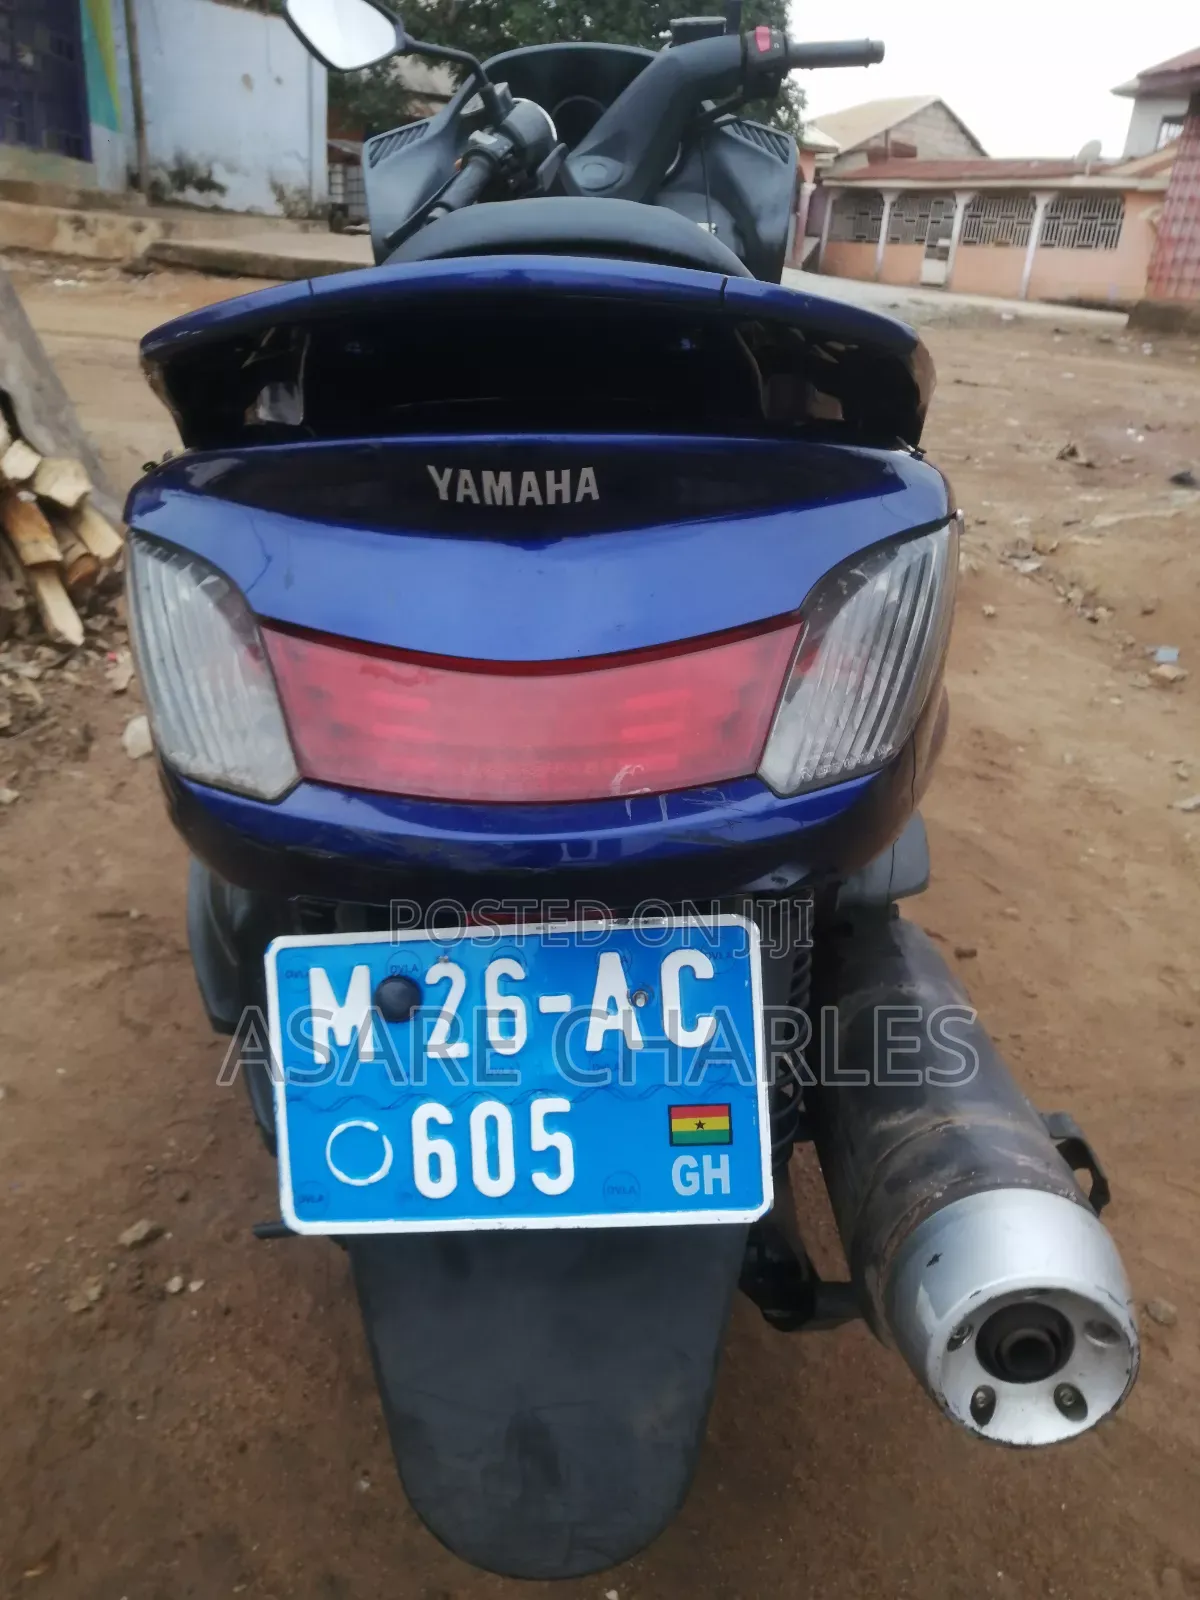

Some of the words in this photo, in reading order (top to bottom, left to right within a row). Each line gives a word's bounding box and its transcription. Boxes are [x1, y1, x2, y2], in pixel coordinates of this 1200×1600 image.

[426, 464, 600, 506] YAMAHA
[309, 964, 375, 1065] M
[410, 1097, 576, 1200] 605
[671, 1153, 731, 1197] GH
